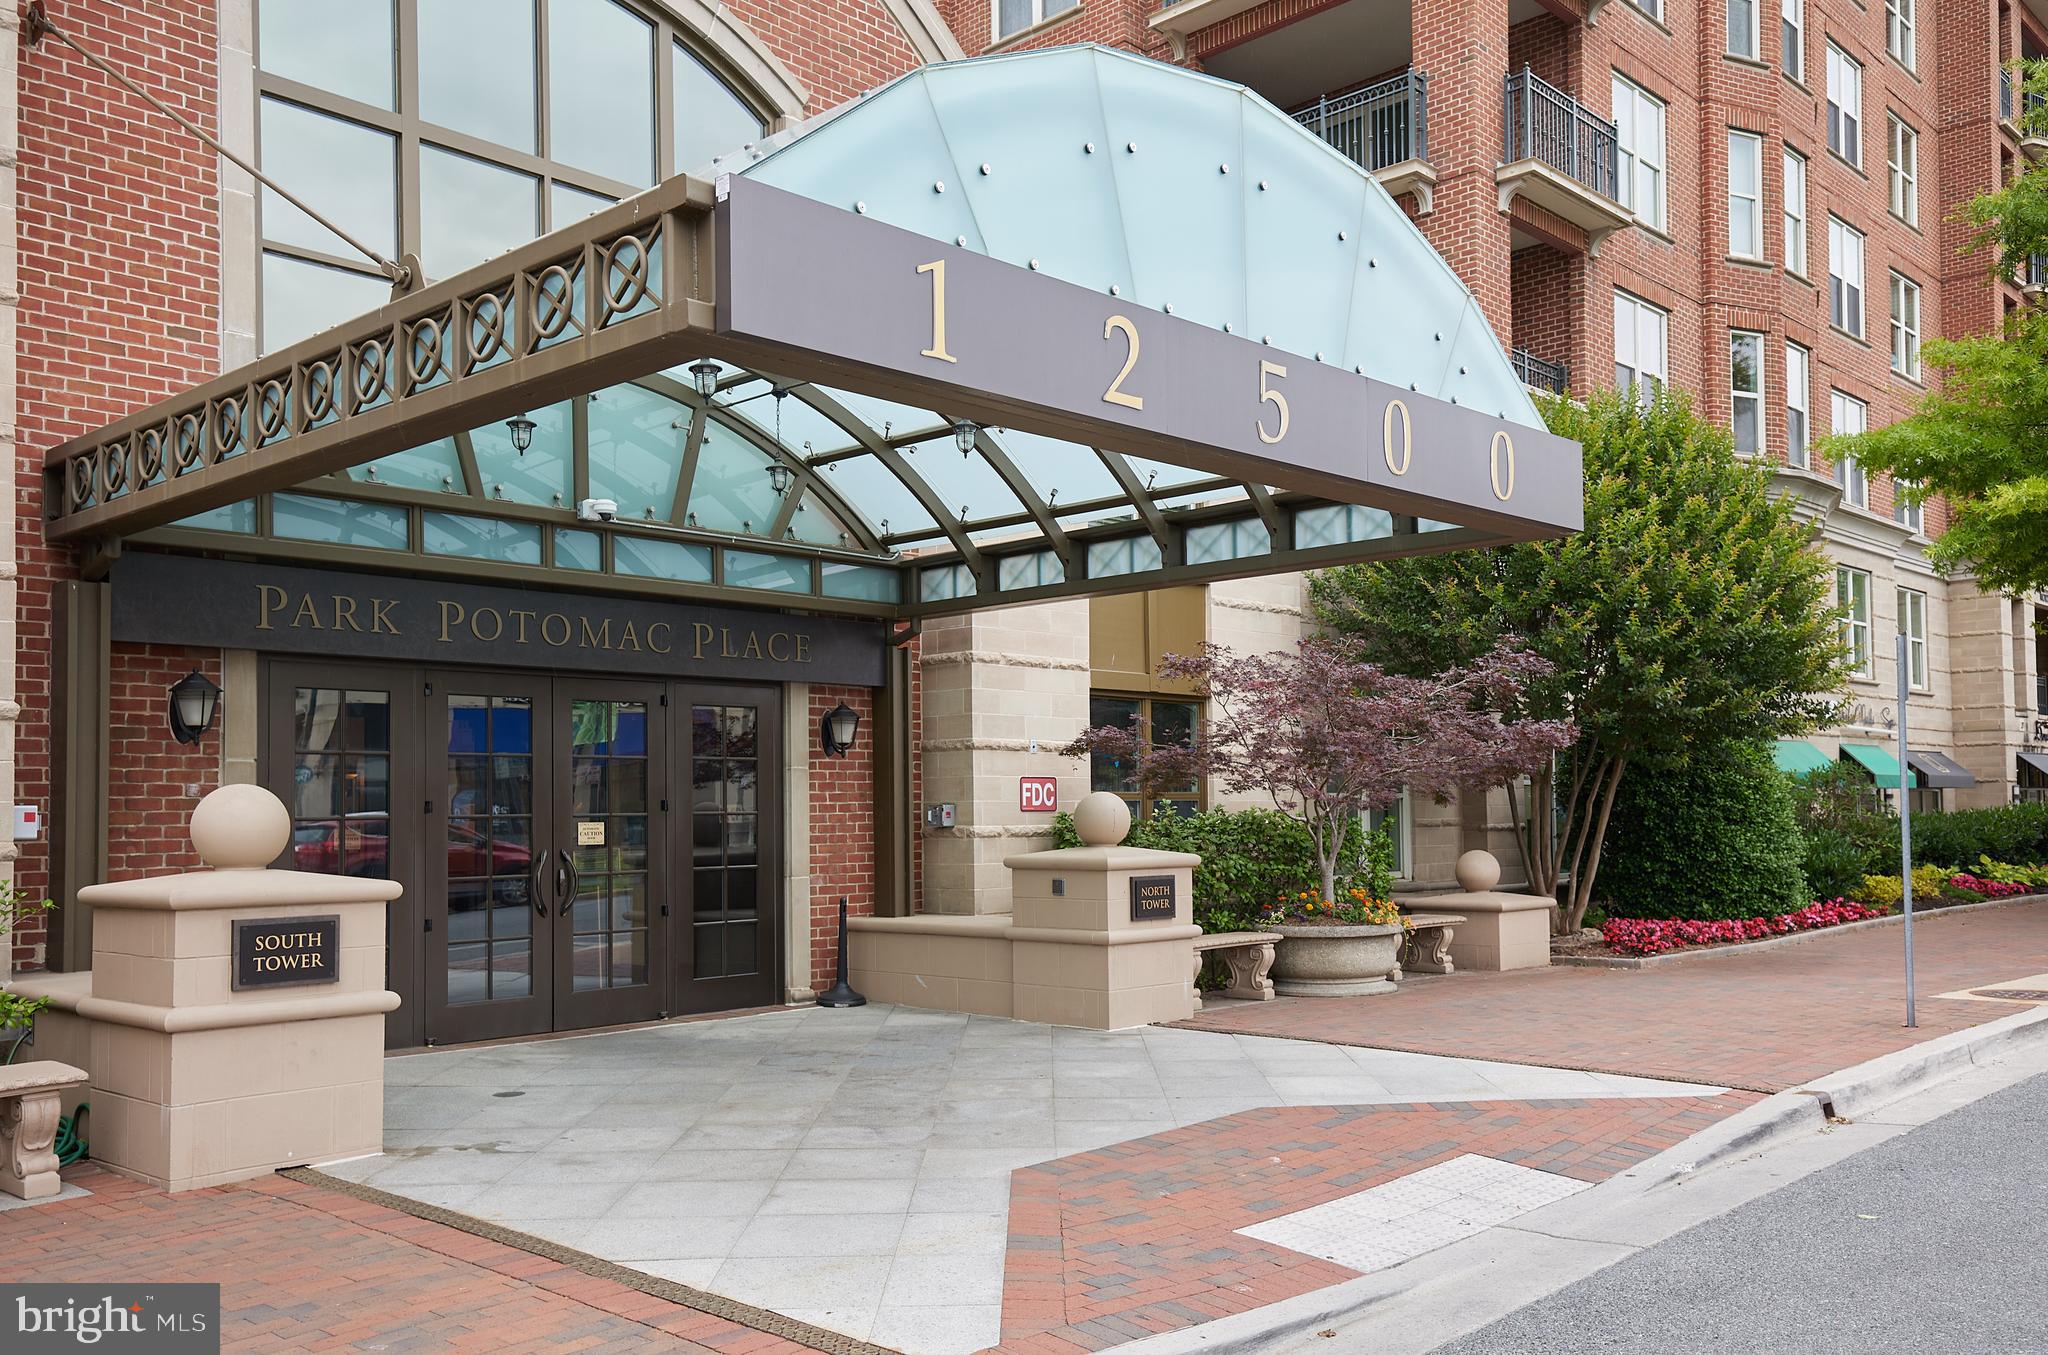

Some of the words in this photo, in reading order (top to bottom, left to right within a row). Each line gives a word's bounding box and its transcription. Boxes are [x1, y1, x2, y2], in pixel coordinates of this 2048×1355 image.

[255, 584, 402, 635] PARK
[437, 600, 672, 654] POTOMAC
[692, 623, 813, 663] PLACE
[1022, 782, 1055, 807] FDC
[1141, 886, 1171, 897] NORTH
[1141, 899, 1171, 910] TOWER
[255, 932, 323, 951] SOUTH
[253, 953, 325, 972] TOWER
